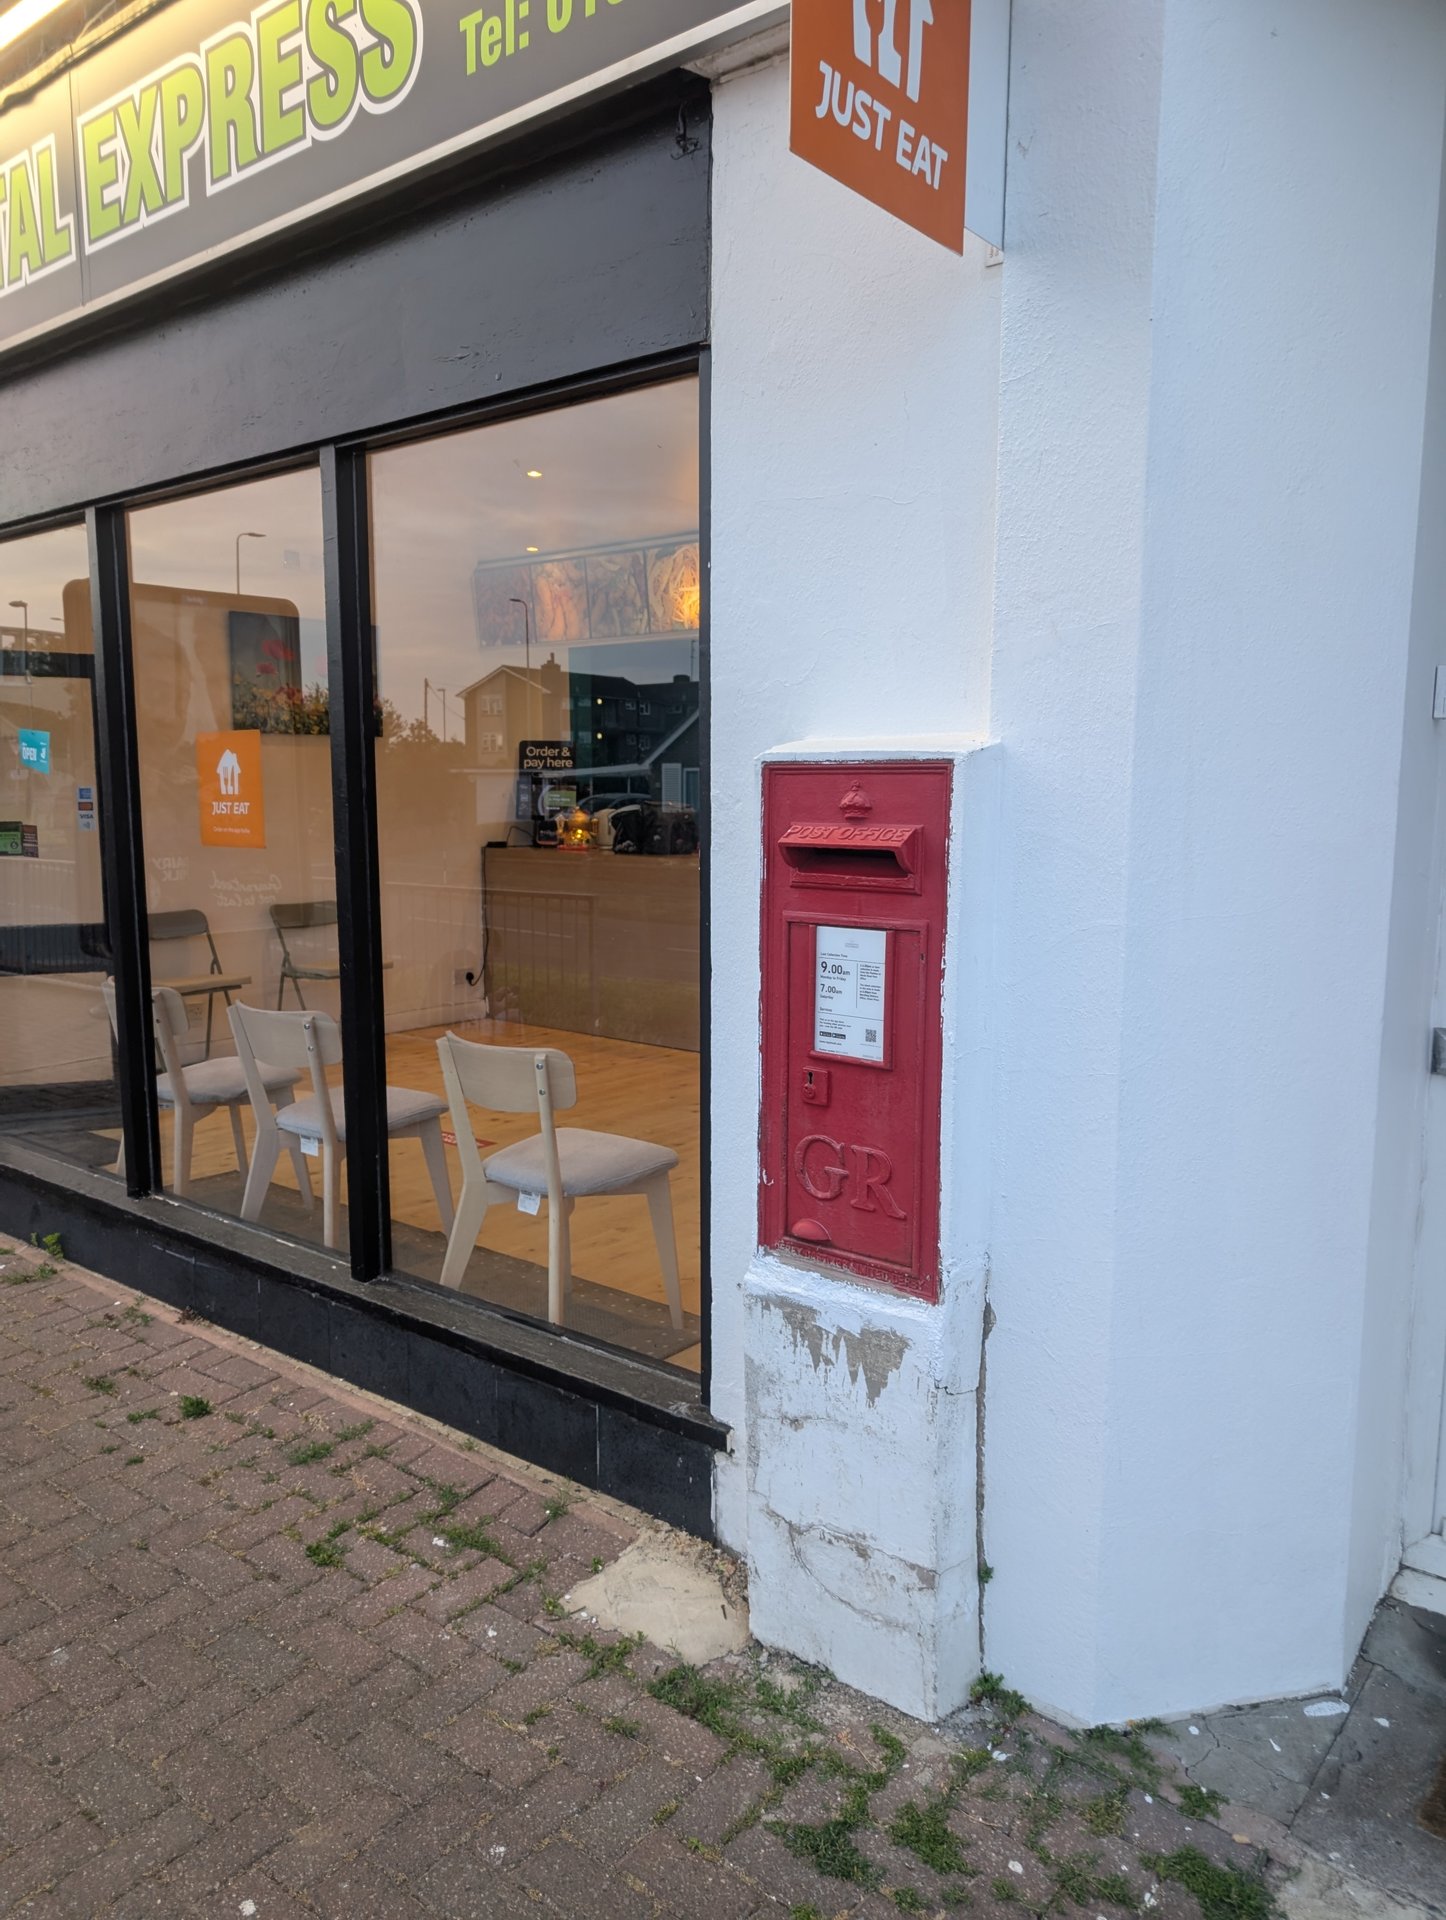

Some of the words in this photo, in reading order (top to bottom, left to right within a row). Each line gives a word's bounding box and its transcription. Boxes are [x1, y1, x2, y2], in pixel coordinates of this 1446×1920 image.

[459, 0, 529, 76] Tel:
[815, 60, 891, 151] JUST
[896, 119, 948, 190] EAT
[0, 139, 74, 292] AL
[78, 0, 421, 254] EXPRESS
[22, 746, 37, 761] OPEN
[526, 746, 560, 757] Order
[561, 746, 570, 757] &
[523, 758, 545, 770] pay
[546, 757, 573, 768] here
[211, 801, 232, 815] JUST
[233, 802, 250, 815] EAT
[783, 824, 838, 840] POST
[838, 826, 912, 843] OFFICE
[820, 960, 851, 976] 9.00am
[820, 983, 843, 994] 7.00am
[794, 1134, 907, 1219] GR
